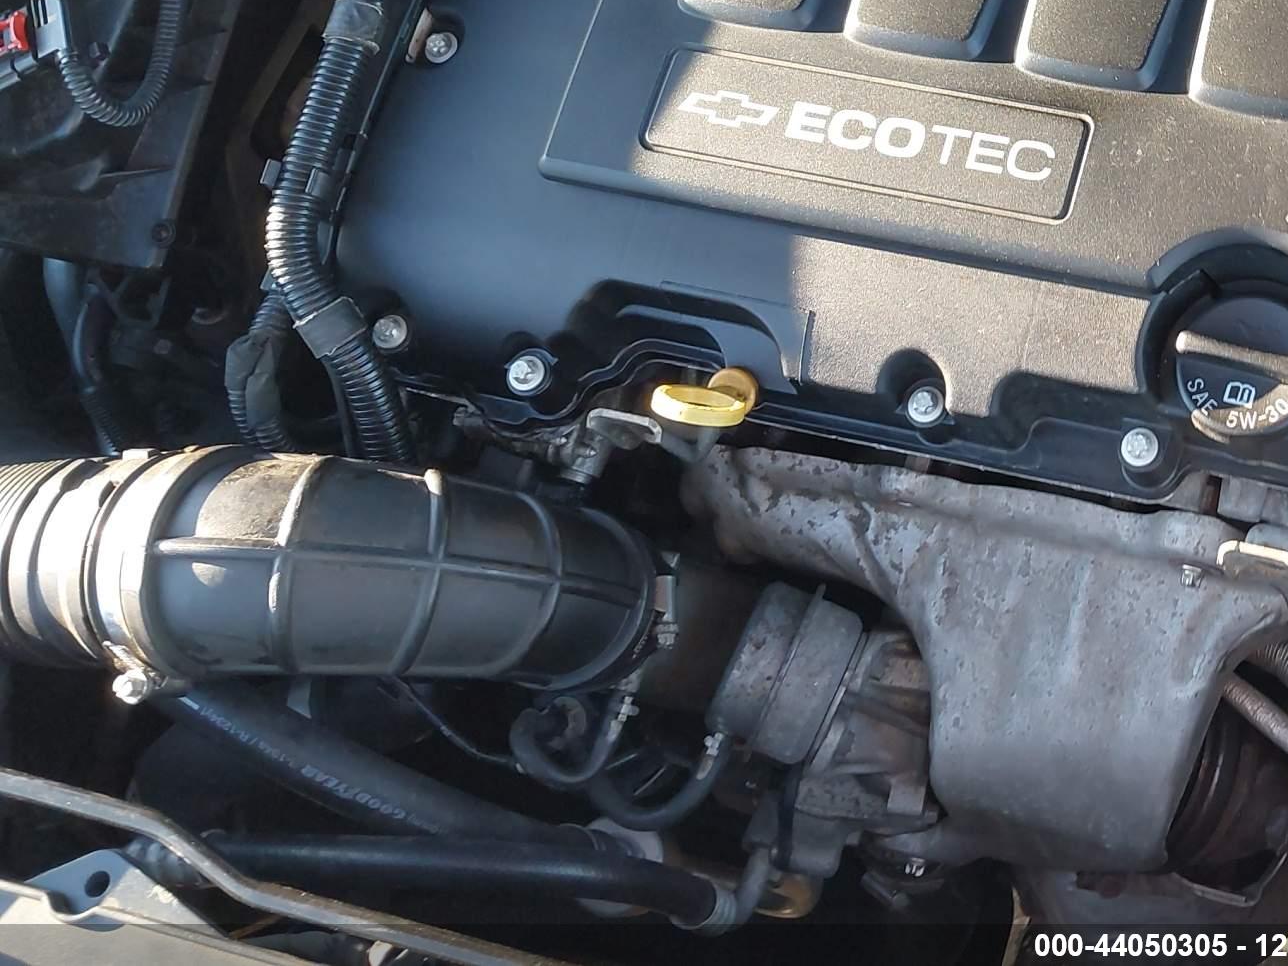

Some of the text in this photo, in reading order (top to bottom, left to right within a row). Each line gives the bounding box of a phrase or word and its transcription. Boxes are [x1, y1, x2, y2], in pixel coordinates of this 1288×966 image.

[785, 102, 1056, 182] ECOTEC
[1187, 377, 1218, 416] SAE
[301, 764, 406, 820] GOODYEAR
